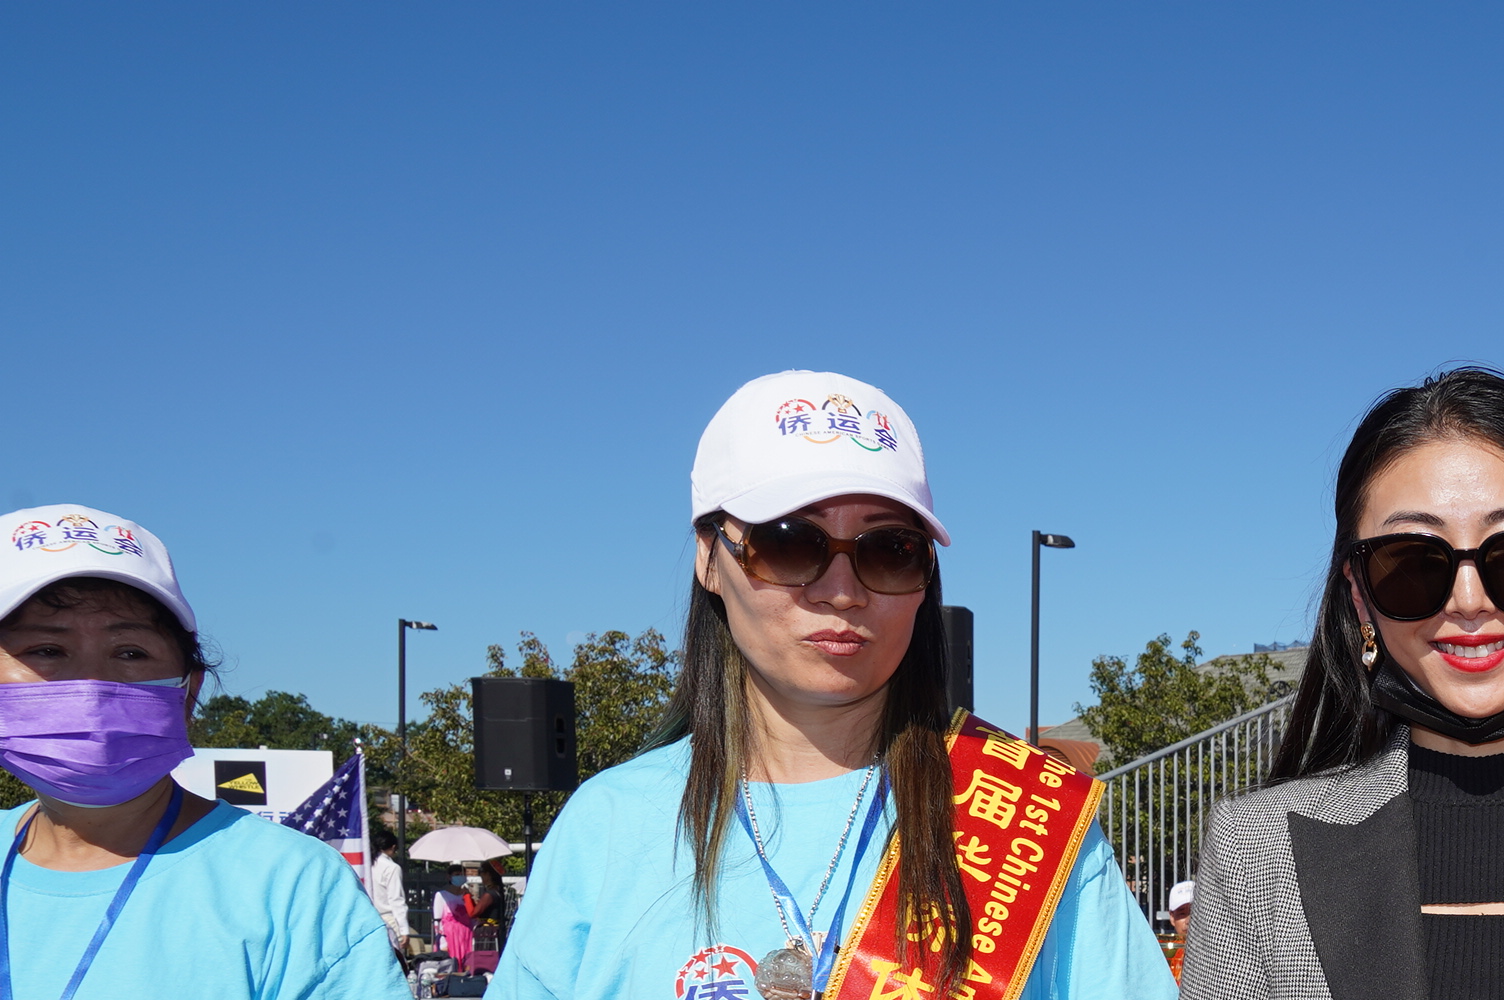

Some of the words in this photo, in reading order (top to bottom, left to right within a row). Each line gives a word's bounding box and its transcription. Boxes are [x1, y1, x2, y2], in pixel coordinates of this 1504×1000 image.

[778, 412, 898, 452] 侨运会
[15, 526, 144, 558] 侨运会
[1019, 794, 1062, 836] 1st
[971, 837, 1045, 953] Chinese
